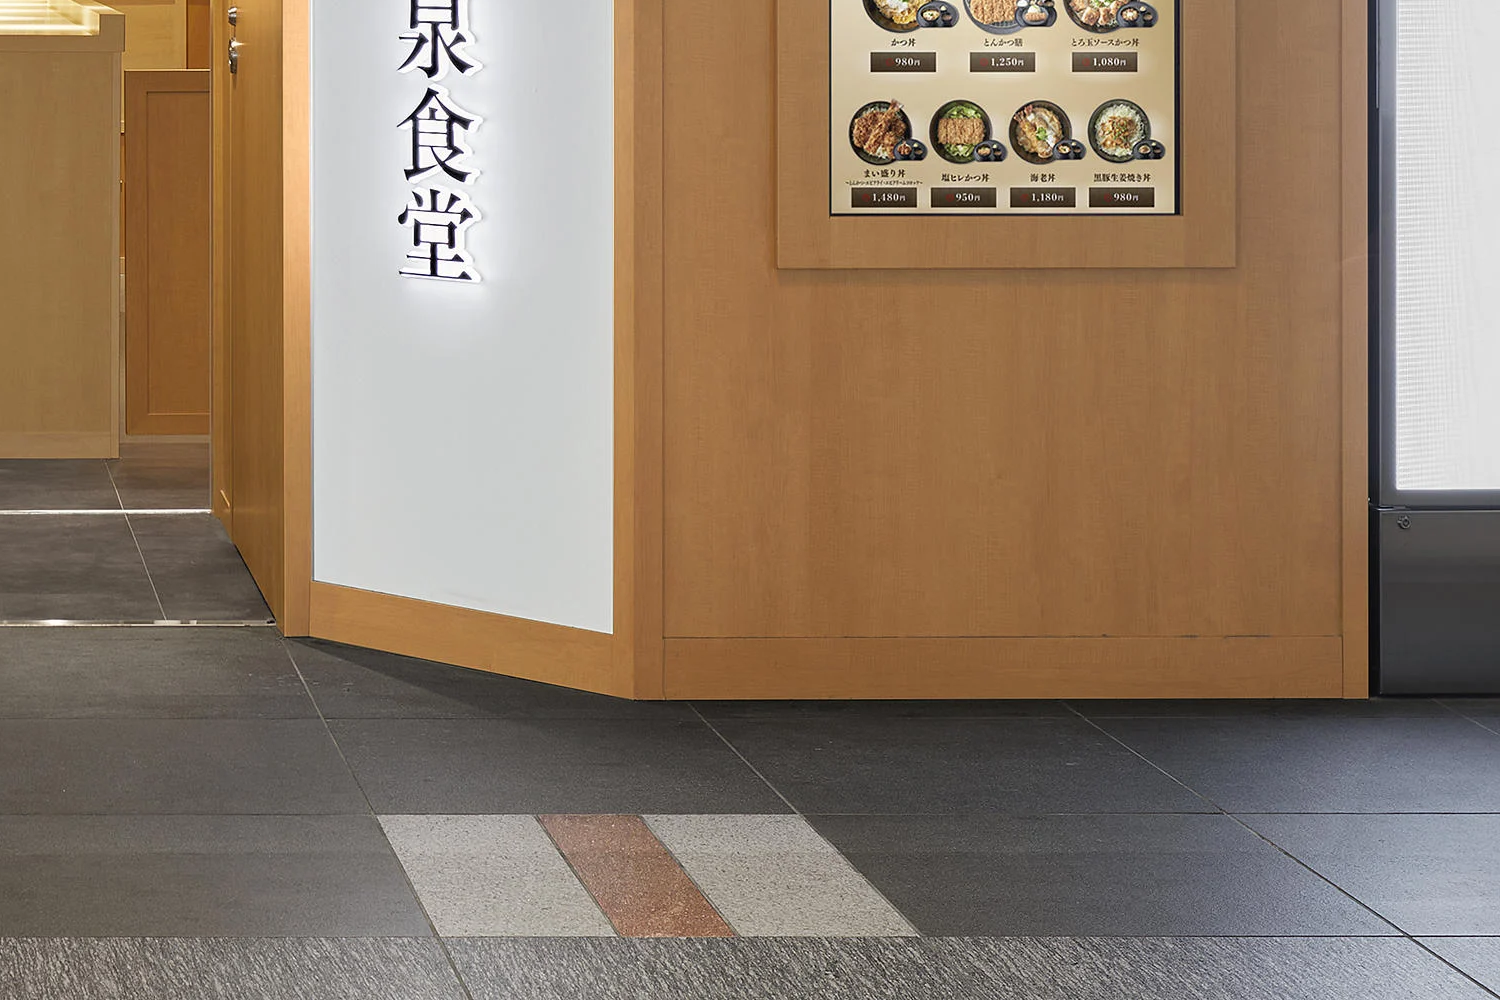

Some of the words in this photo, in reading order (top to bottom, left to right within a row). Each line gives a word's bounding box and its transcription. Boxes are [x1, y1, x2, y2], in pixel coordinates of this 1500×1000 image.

[890, 37, 917, 47] かつ丼
[894, 57, 921, 67] 980円
[990, 57, 1025, 67] 1,250円
[1092, 57, 1127, 67] 1,080円
[863, 168, 906, 179] まい盛り丼
